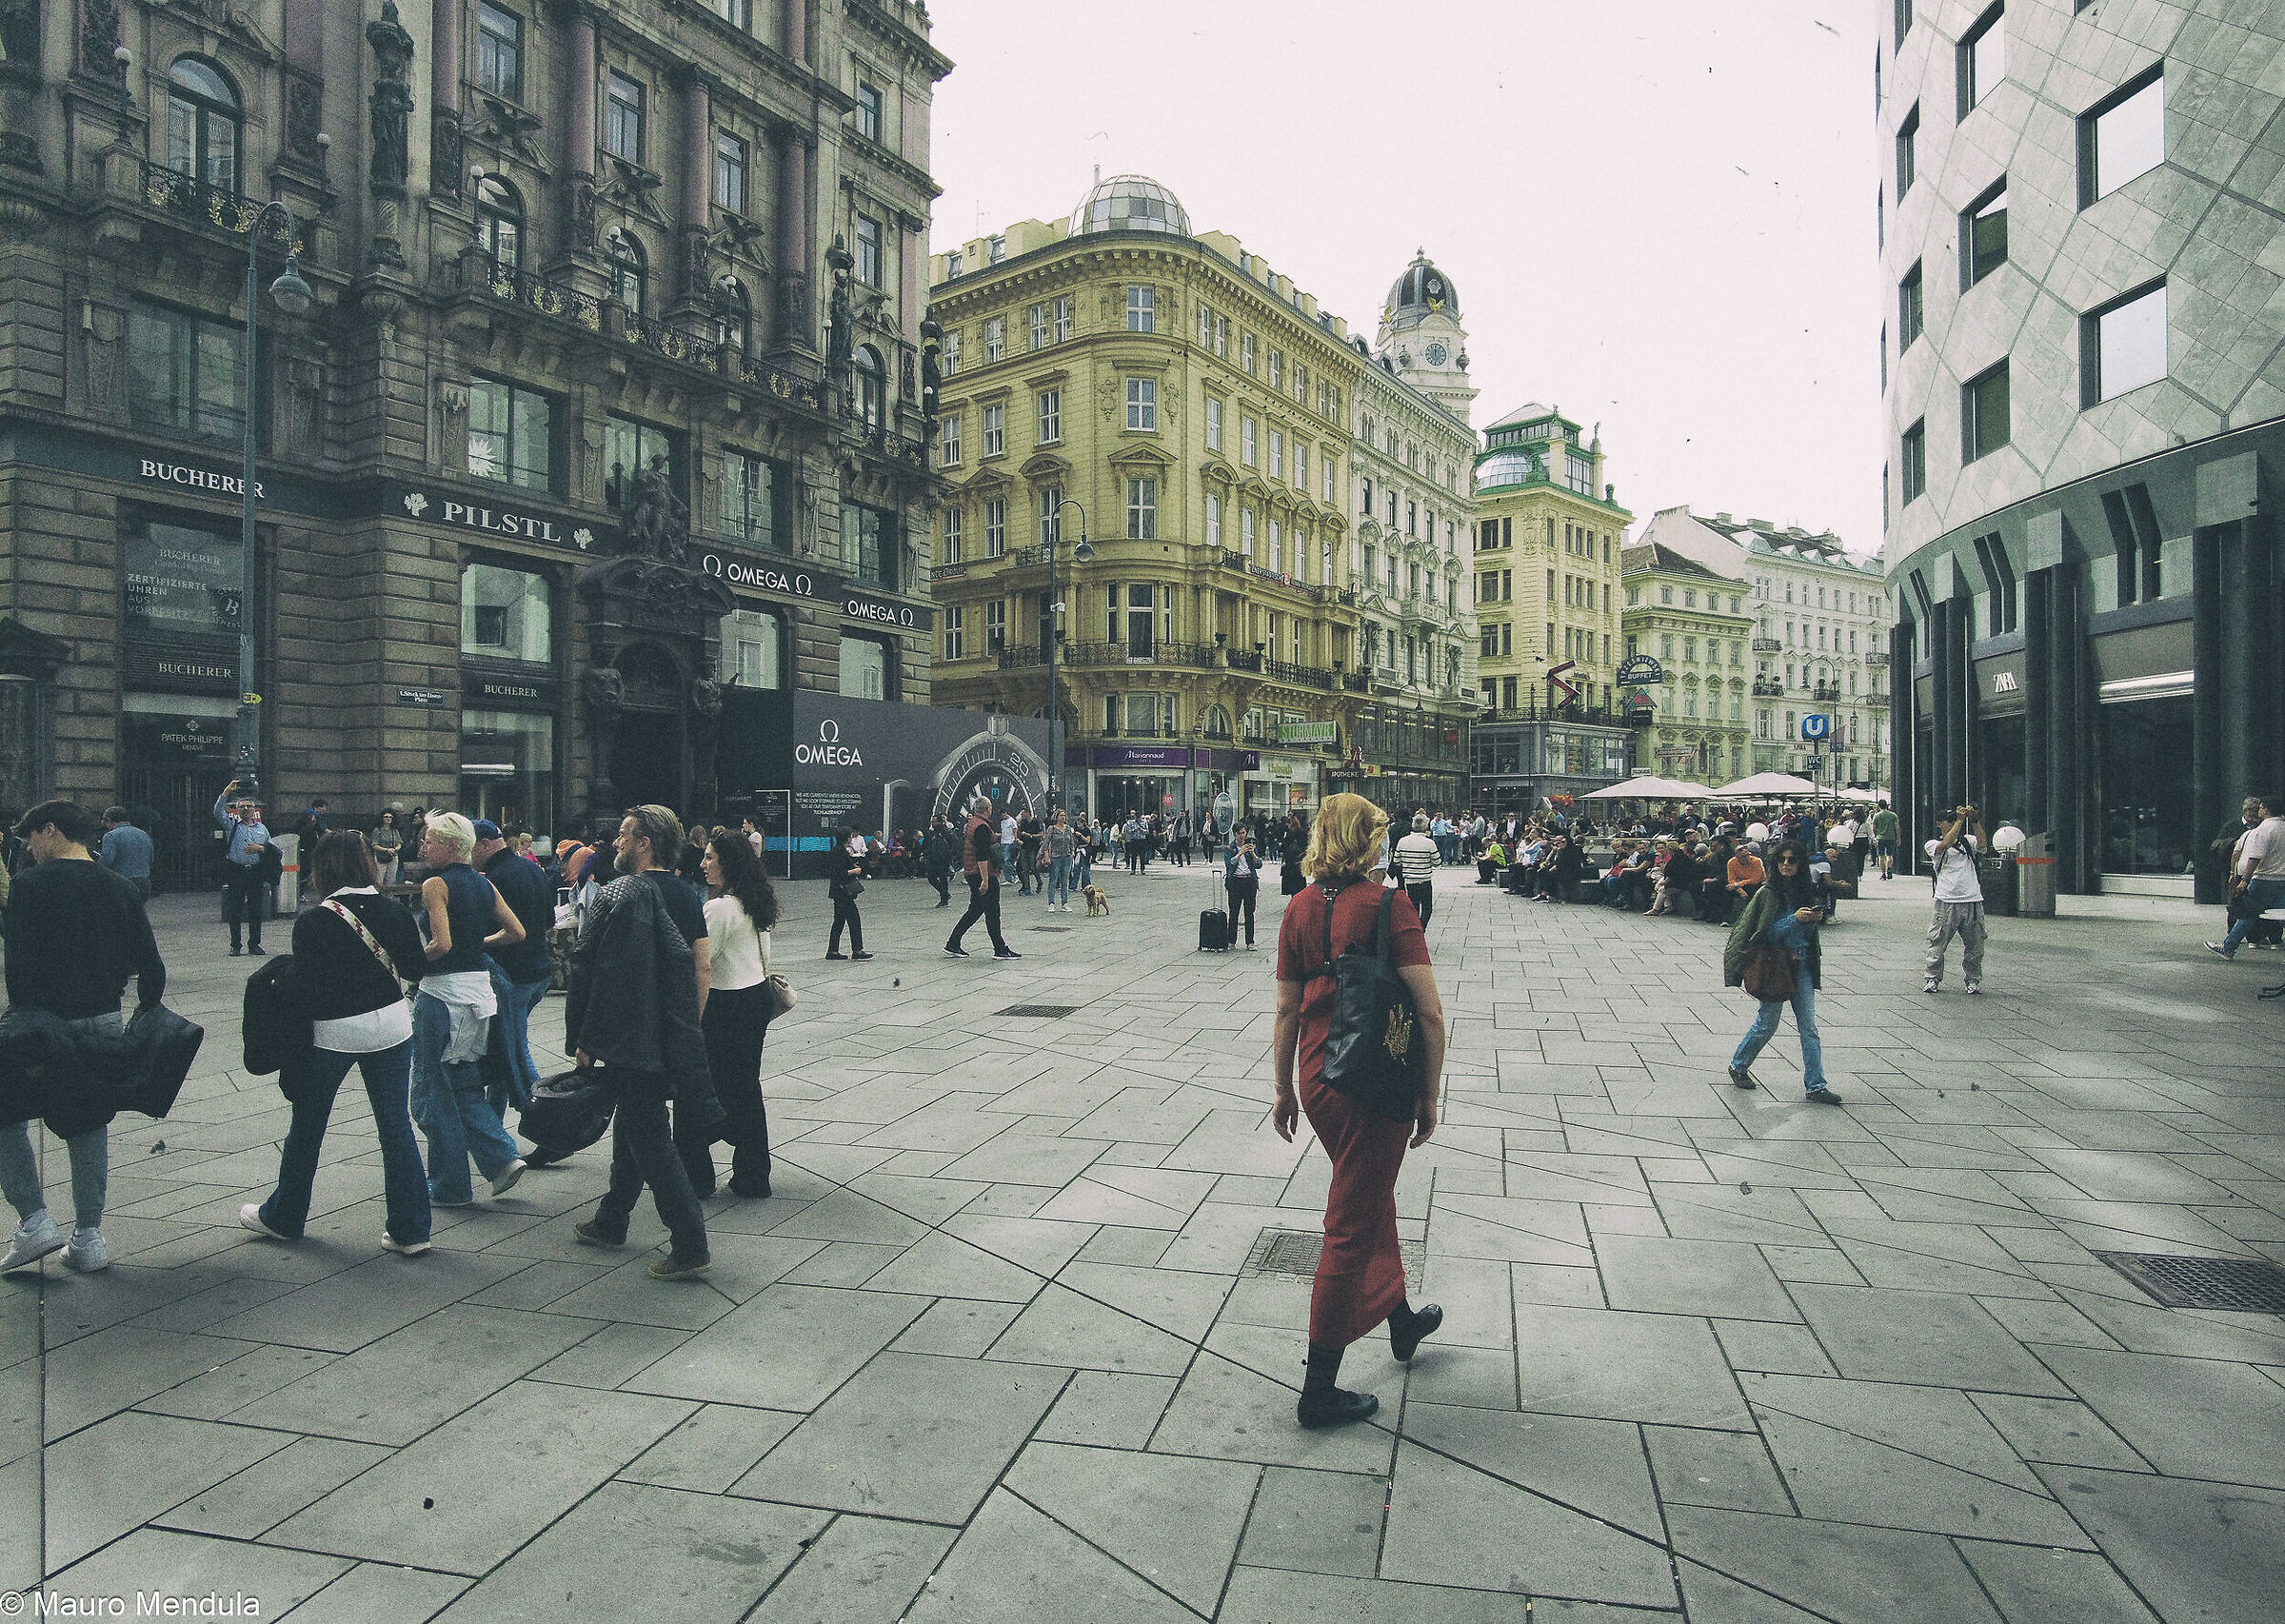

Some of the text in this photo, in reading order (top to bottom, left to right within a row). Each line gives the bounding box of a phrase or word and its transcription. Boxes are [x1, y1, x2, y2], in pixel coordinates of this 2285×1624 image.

[140, 459, 266, 499] BUCHERER
[443, 501, 562, 543] PILSTL
[160, 548, 221, 565] BUCHERER
[128, 573, 208, 591] ZERTIFIZIERTE
[727, 563, 790, 592] OMEGA
[128, 584, 168, 596] UHREN
[128, 595, 150, 604] AUS
[847, 599, 896, 624] OMEGA
[158, 663, 233, 679] BUCHERER
[484, 683, 538, 698] BUCHERER
[1993, 671, 2019, 693] ZARA
[161, 734, 224, 744] PATEK PHILIPPE
[795, 743, 864, 766] OMEGA
[1331, 770, 1360, 779] APOTHEKE
